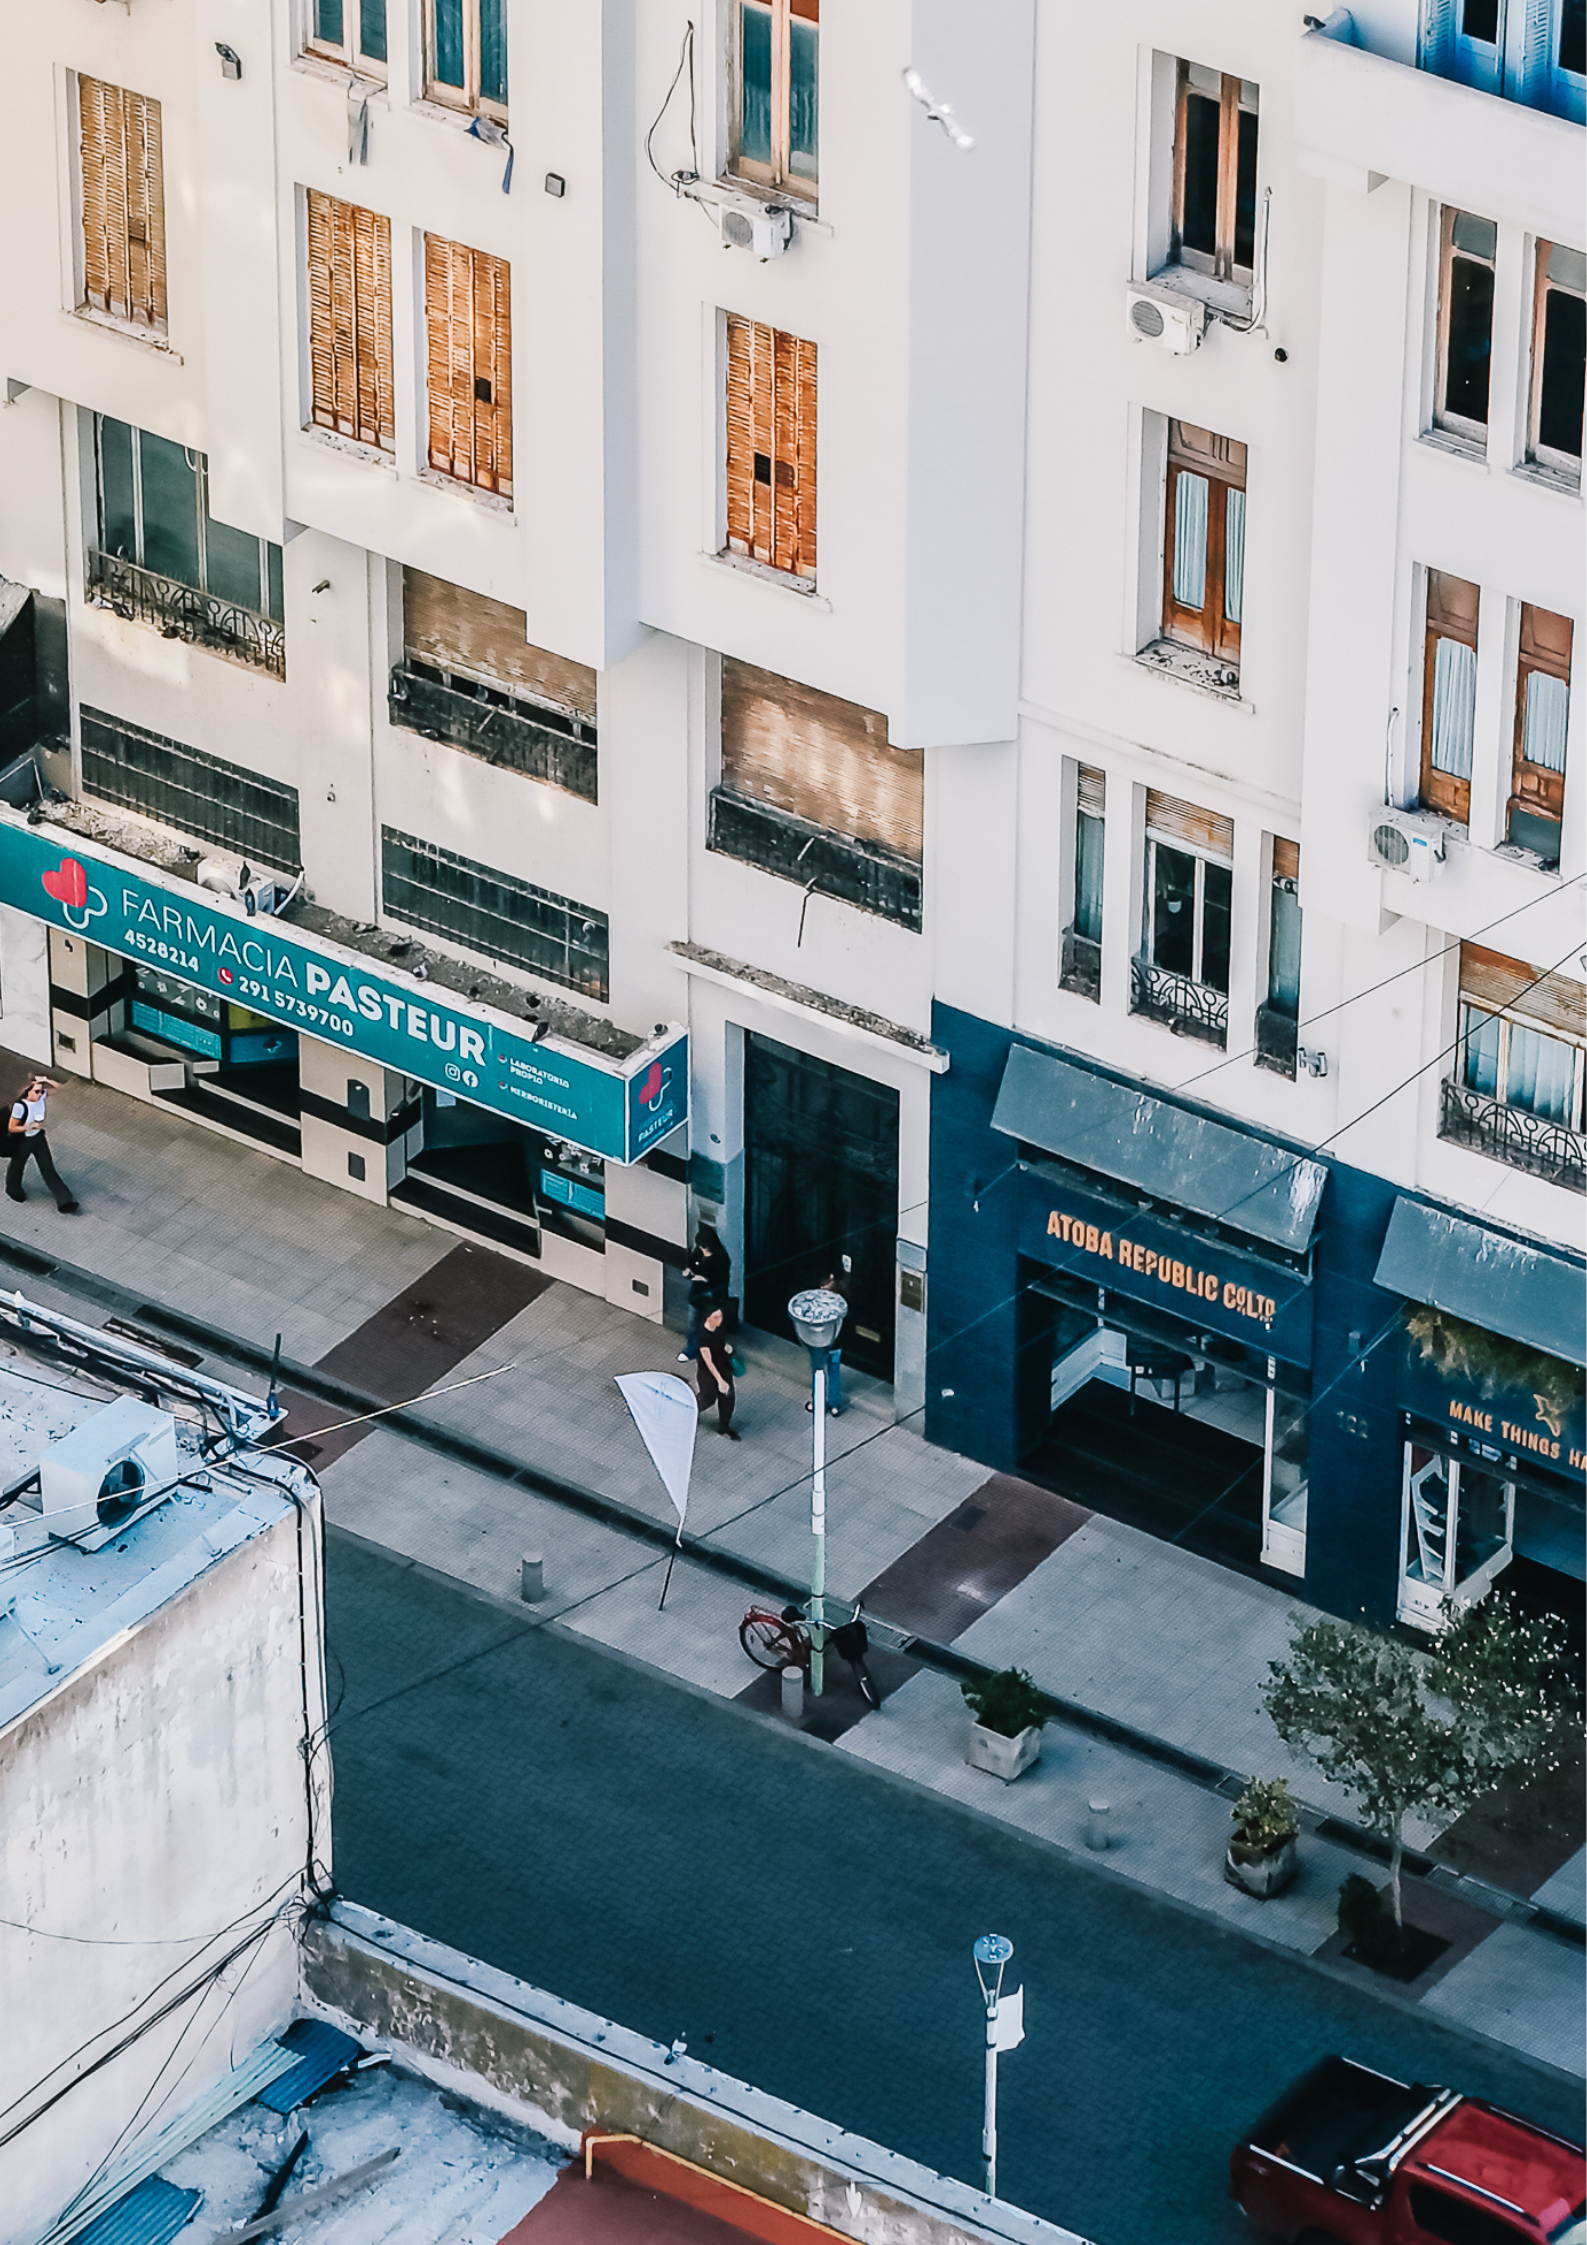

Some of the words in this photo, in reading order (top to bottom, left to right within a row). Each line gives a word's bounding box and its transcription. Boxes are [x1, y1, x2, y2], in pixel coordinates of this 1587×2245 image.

[122, 888, 298, 988] FARMACIA
[307, 963, 487, 1067] PASTEUR
[124, 928, 200, 972] 4528214
[239, 975, 271, 1002] 291
[274, 990, 354, 1037] 5739700
[509, 1057, 570, 1089] LABORATORIO
[509, 1065, 544, 1086] PROPIO
[637, 1108, 674, 1143] PASTEUR
[1047, 1211, 1113, 1259] ATOBA
[1118, 1239, 1219, 1301] REPUBLIC
[1449, 1400, 1493, 1432] MAKE
[1502, 1421, 1561, 1460] THINGS
